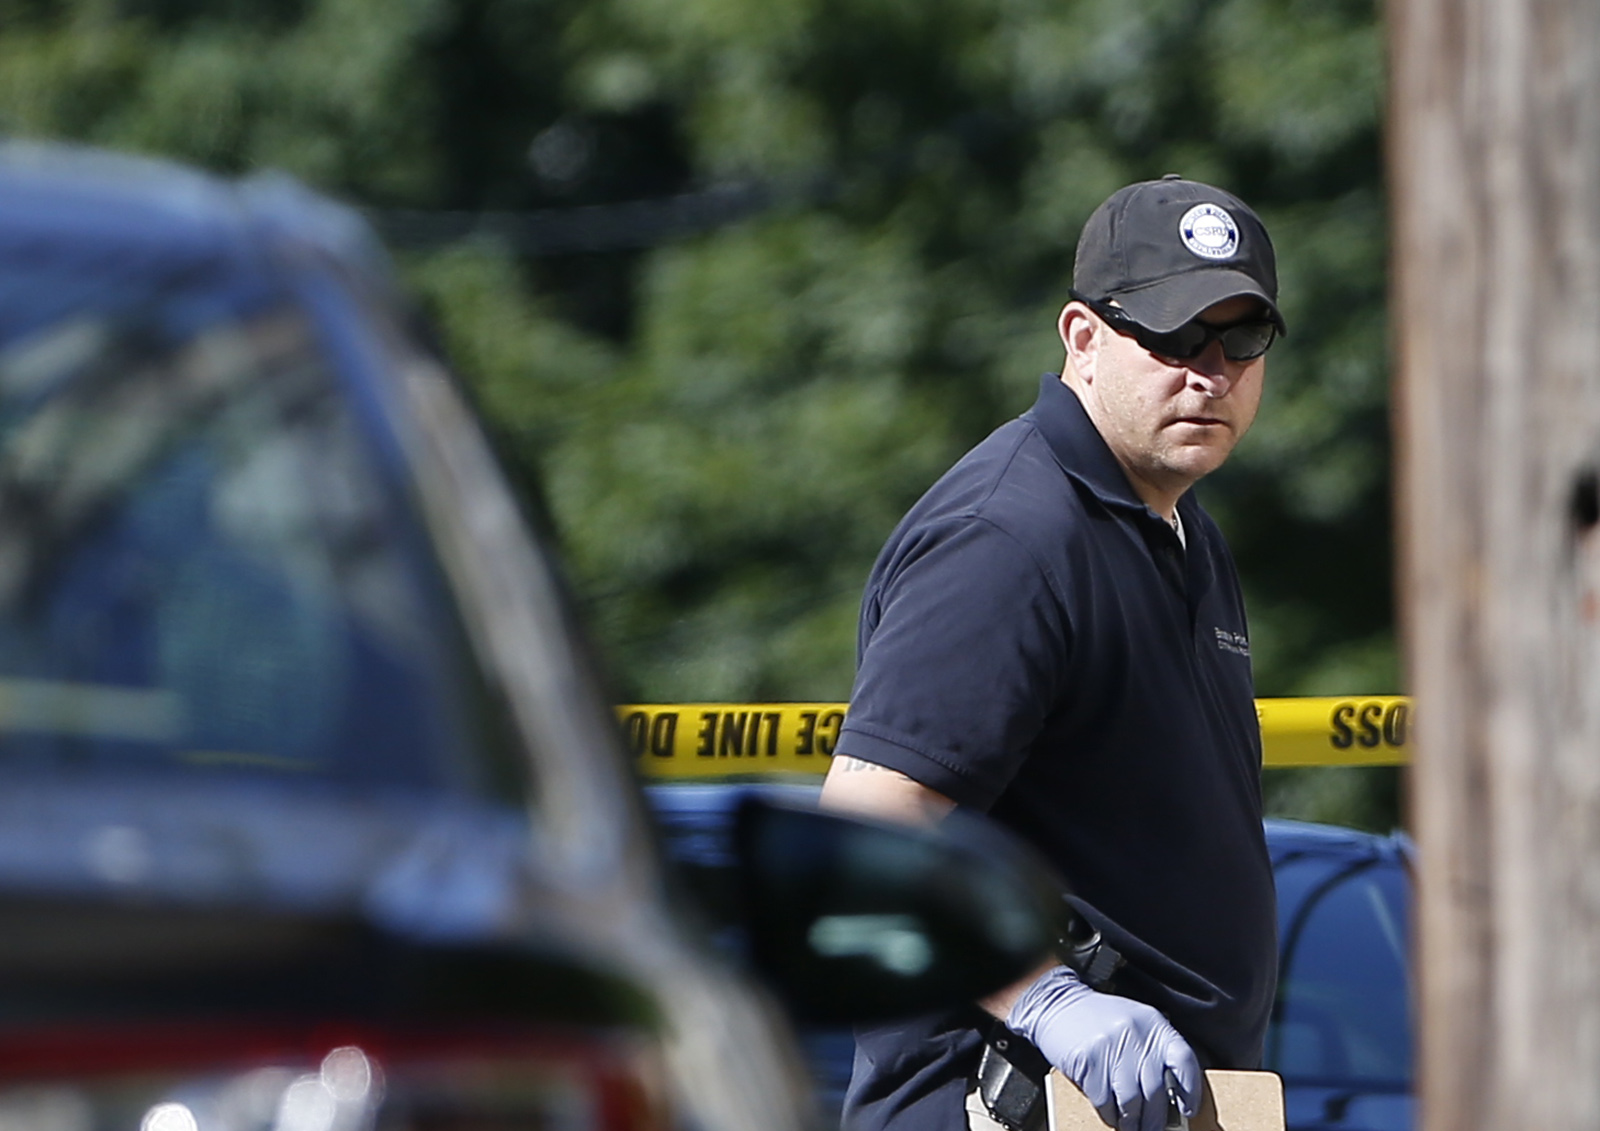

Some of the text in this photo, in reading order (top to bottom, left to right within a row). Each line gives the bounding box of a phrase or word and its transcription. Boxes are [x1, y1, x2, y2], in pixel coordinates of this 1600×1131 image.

[626, 710, 679, 757] DO
[697, 711, 781, 757] LINE
[1331, 704, 1408, 749] OSS
